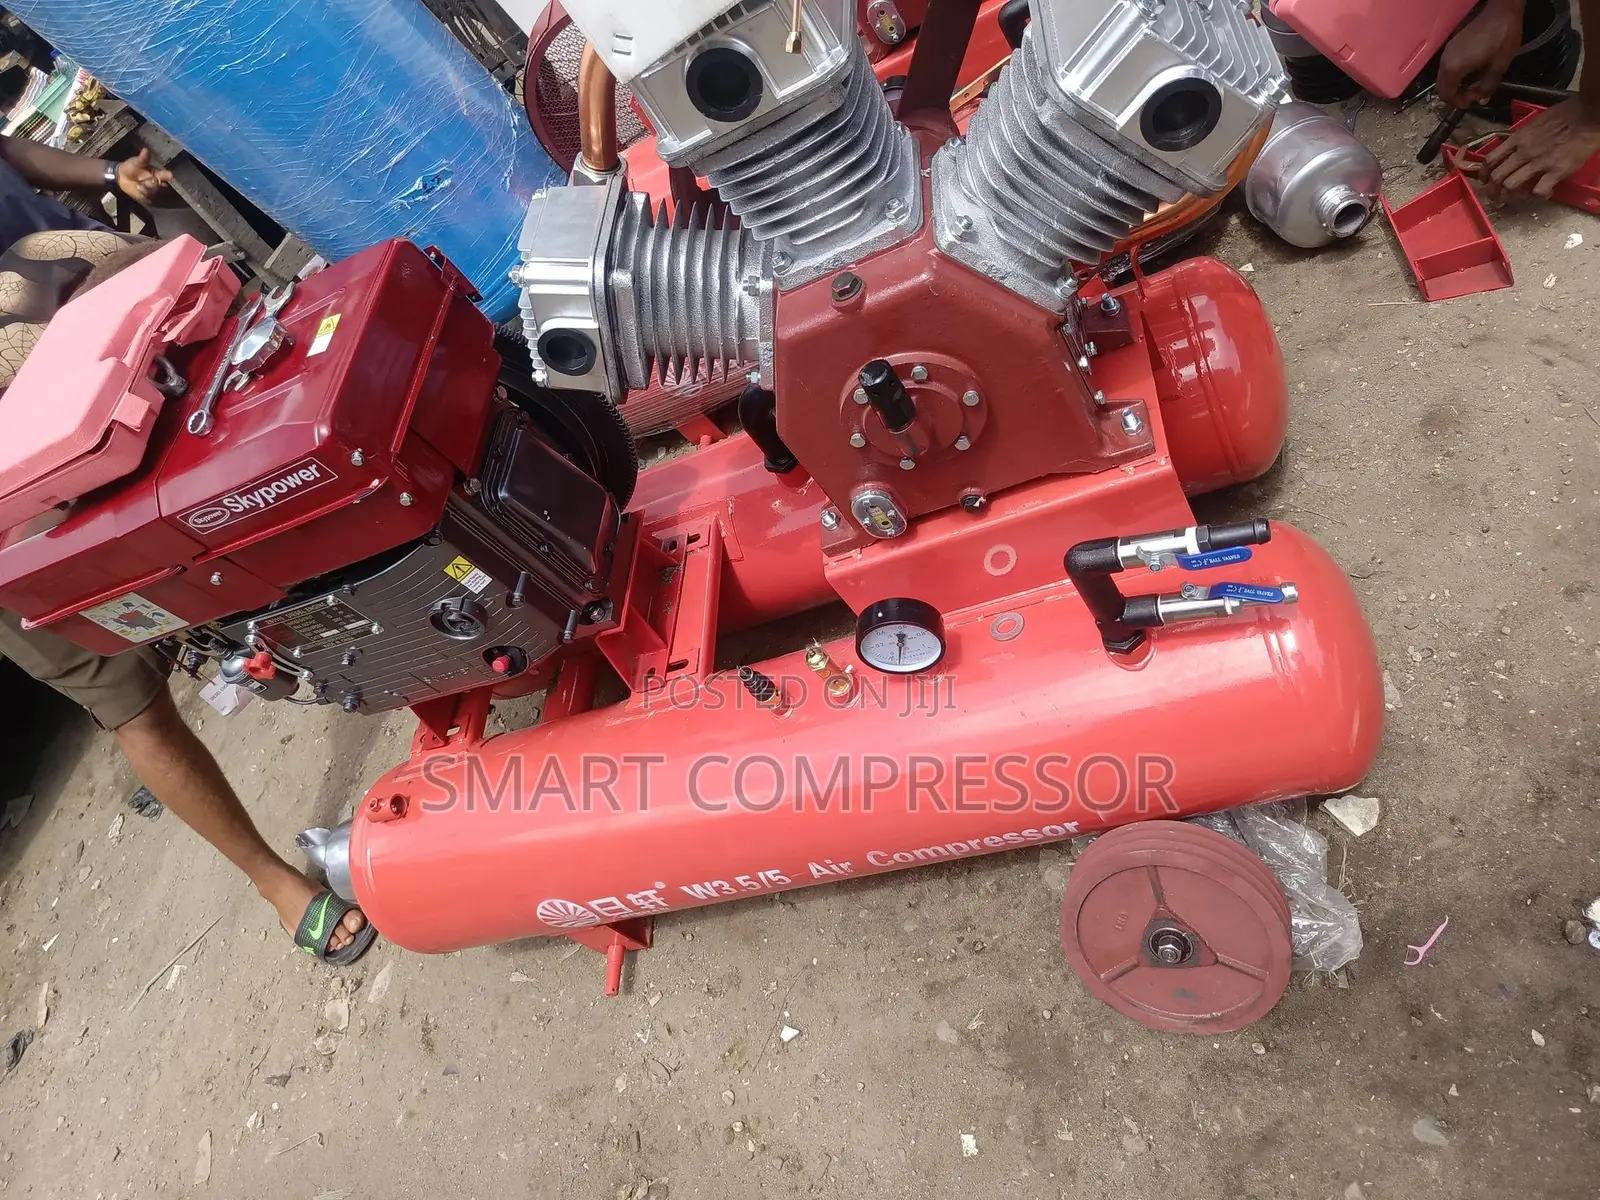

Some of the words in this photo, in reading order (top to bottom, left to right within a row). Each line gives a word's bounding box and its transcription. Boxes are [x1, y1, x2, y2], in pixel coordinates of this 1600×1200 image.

[223, 463, 321, 513] Skypower
[807, 858, 853, 879] Air
[866, 819, 1081, 867] Compressor
